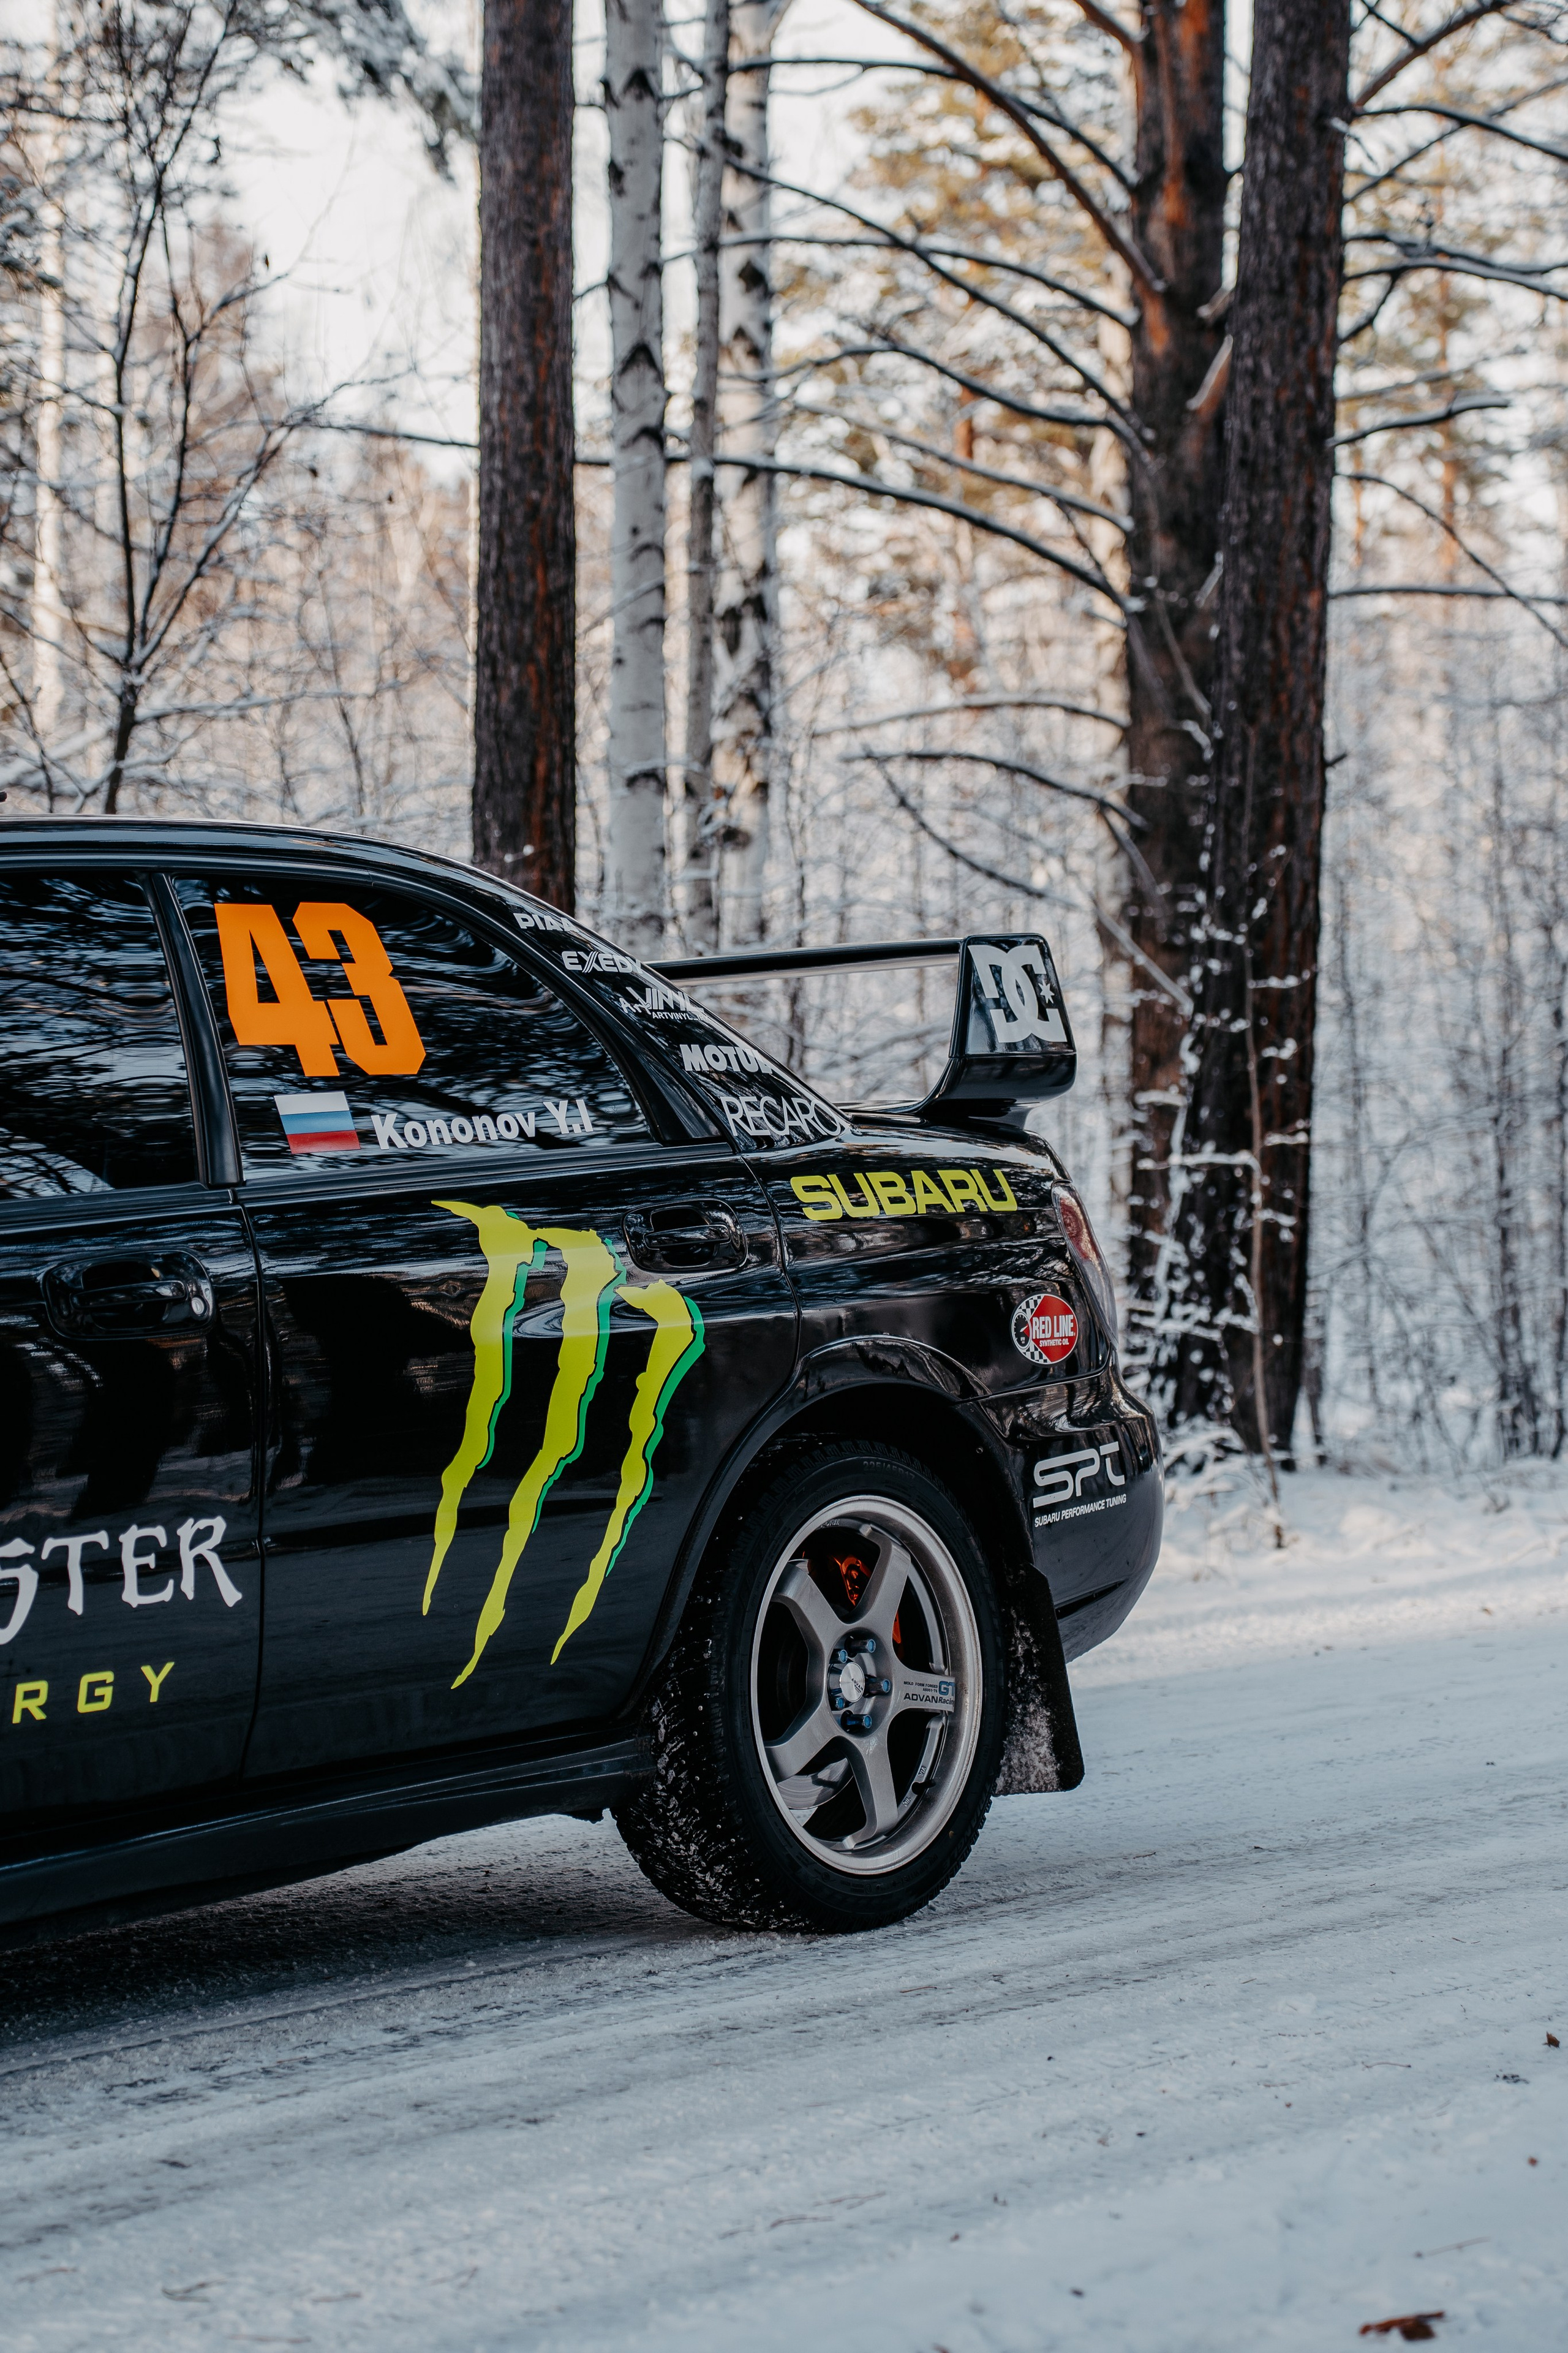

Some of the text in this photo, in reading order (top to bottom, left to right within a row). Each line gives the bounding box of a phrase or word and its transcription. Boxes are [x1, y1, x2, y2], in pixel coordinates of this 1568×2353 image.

[513, 913, 579, 932] PIAA
[562, 951, 643, 975] EXEDY
[214, 902, 426, 1076] 43
[968, 945, 1066, 1043] DC
[680, 1044, 773, 1075] MOTUL
[371, 1112, 535, 1150] Kononov
[720, 1096, 841, 1136] RECARO
[790, 1169, 1017, 1221] SUBARU
[1033, 1314, 1074, 1340] RED LINE
[1039, 1339, 1061, 1347] SYNTHETIC
[1033, 1441, 1126, 1508] SPT
[1035, 1494, 1127, 1528] SUBARU PERFORMANCE TUNING
[12, 1661, 175, 1724] RGY
[903, 1693, 938, 1704] ADVAN
